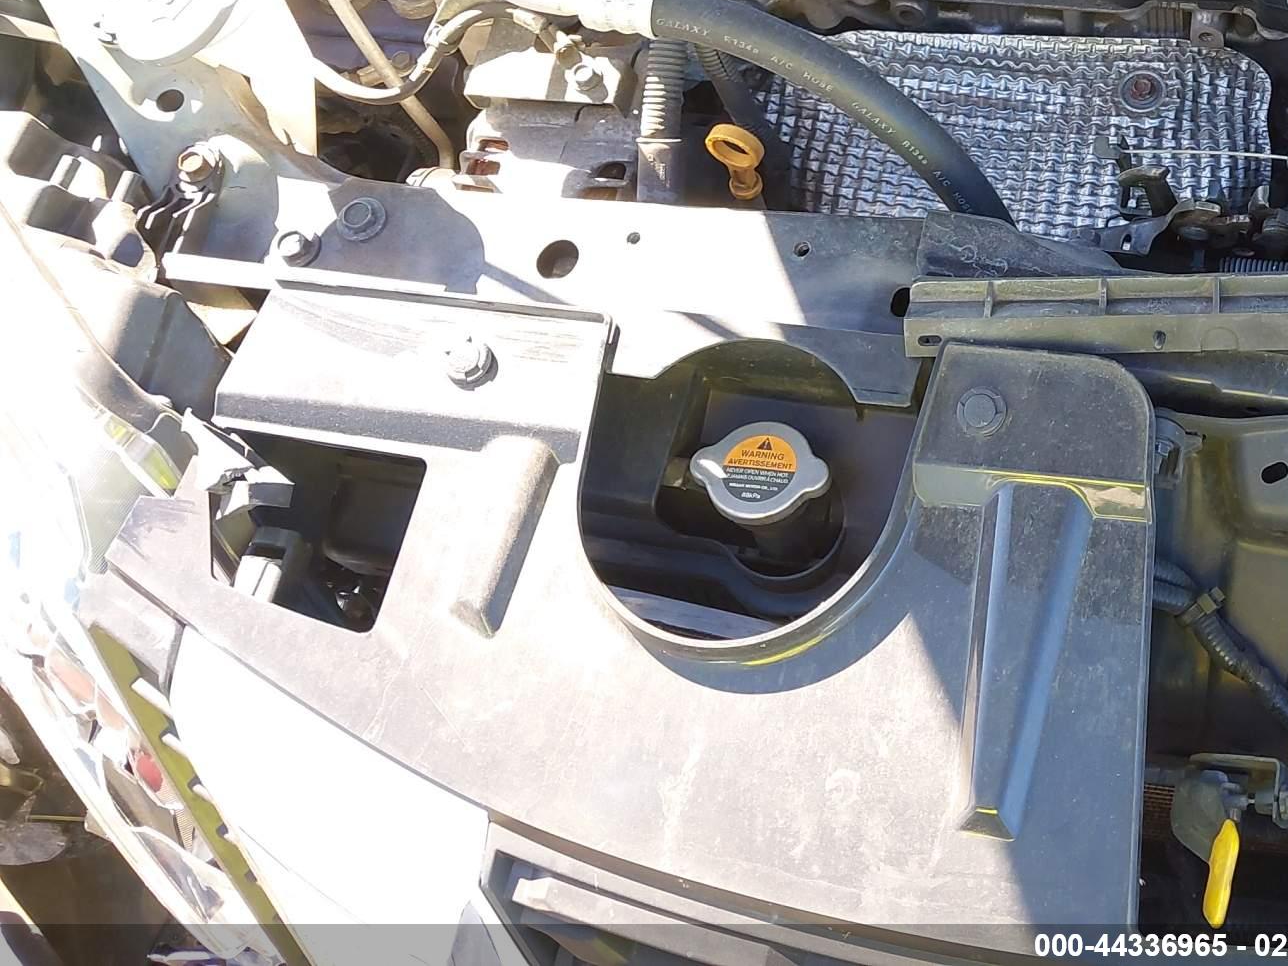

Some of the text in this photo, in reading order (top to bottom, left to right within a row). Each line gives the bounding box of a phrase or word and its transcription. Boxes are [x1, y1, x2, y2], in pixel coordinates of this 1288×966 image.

[656, 18, 710, 37] GALAXY
[770, 56, 793, 70] A/C
[802, 71, 834, 92] HOSE
[851, 102, 896, 134] GALAXY
[741, 449, 785, 460] WARNING
[728, 458, 793, 469] AVERTISSEMENT
